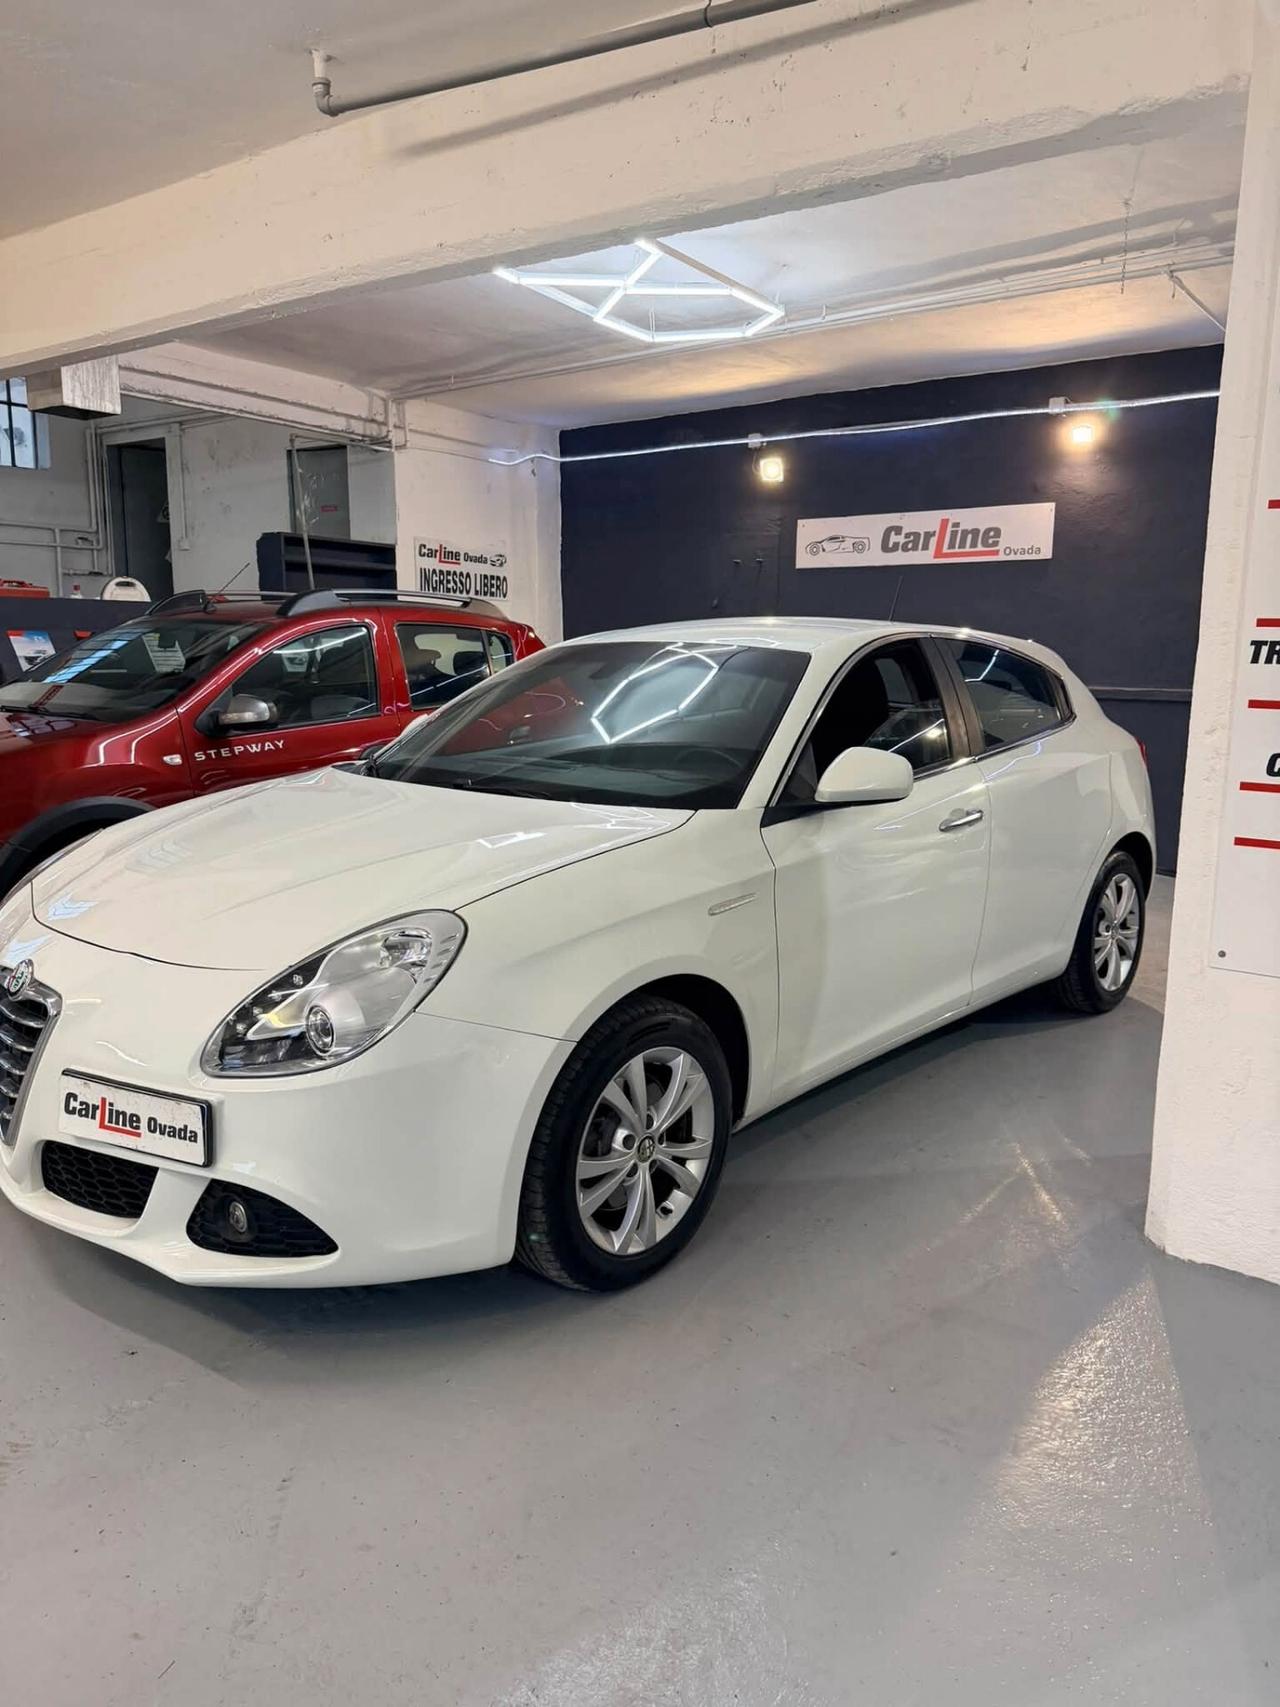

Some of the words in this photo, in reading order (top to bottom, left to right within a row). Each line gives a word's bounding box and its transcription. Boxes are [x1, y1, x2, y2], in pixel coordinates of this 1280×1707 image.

[418, 543, 461, 565] CarLine
[463, 552, 488, 564] Ovada
[881, 518, 1001, 559] CarLine
[1003, 545, 1041, 556] Ovada
[420, 567, 471, 595] INGRESSO
[474, 573, 508, 598] LIBERO
[194, 740, 284, 761] STEPWAY
[64, 1092, 142, 1138] CarLine
[147, 1116, 198, 1143] Ovada
